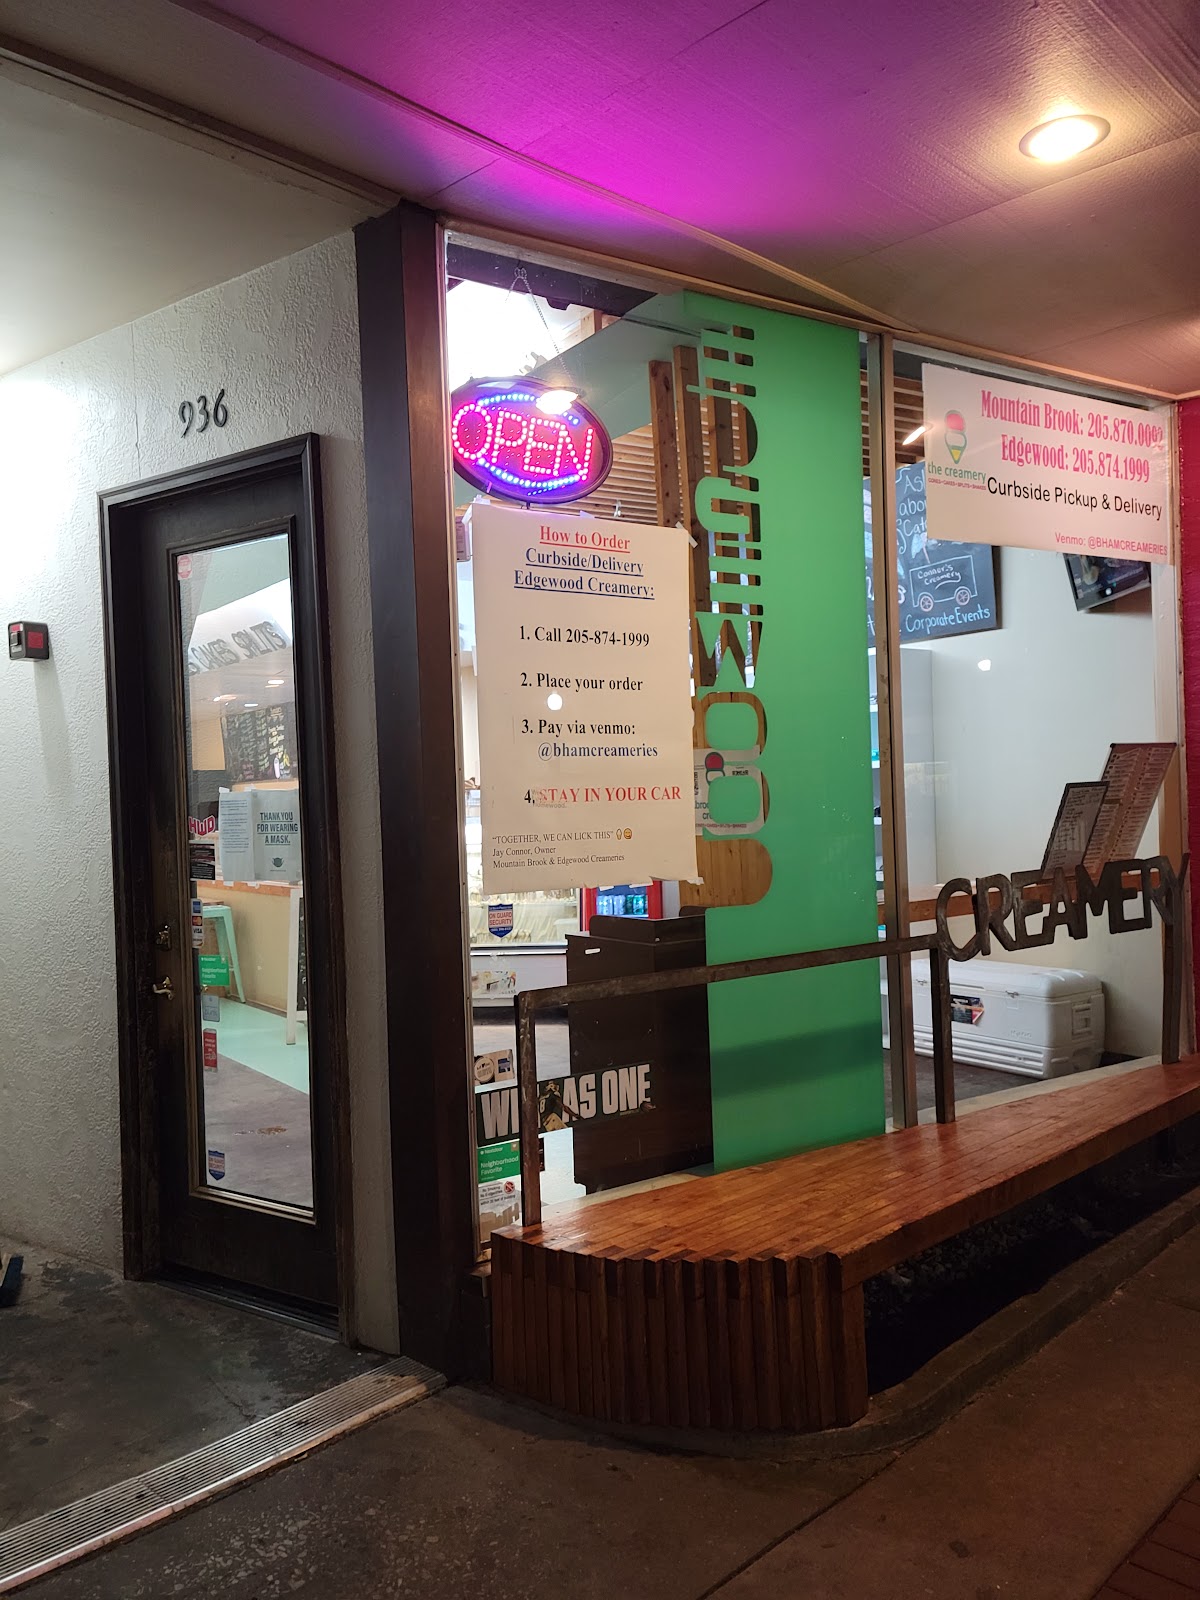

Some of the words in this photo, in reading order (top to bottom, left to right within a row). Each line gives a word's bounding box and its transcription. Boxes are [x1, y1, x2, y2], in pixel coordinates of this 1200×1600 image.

[179, 388, 228, 438] 936
[981, 390, 1040, 427] Mountain
[1044, 403, 1083, 435] Brook:
[452, 403, 593, 481] OPEN
[1001, 434, 1068, 470] Edgewood:
[1072, 447, 1150, 482] 205.874.1999
[928, 461, 942, 475] the
[945, 467, 986, 484] creamery
[987, 477, 1050, 501] Curbside
[1055, 487, 1098, 511] Pickup
[1102, 494, 1110, 510] &
[1115, 496, 1162, 521] Delivery
[540, 525, 571, 543] How
[575, 531, 587, 545] to
[591, 532, 630, 549] Order
[1055, 532, 1086, 546] Venmo:
[1088, 536, 1168, 556] @BHAMCREAMERIES
[525, 547, 644, 574] Curbside/Delivery
[514, 570, 583, 589] Edgewood
[588, 577, 654, 598] Creamery:
[690, 323, 773, 906] EDGEWOOD
[906, 611, 955, 634] Corporate
[954, 604, 990, 623] Events
[520, 625, 530, 640] 1.
[534, 626, 561, 642] Call
[566, 628, 650, 647] 205-874-1999
[520, 672, 532, 687] 2.
[537, 673, 571, 688] Place
[575, 678, 605, 692] your
[609, 677, 643, 691] order
[521, 719, 533, 734] 3.
[538, 719, 563, 737] Pay
[567, 720, 586, 734] via
[590, 724, 636, 735] venmo:
[538, 742, 658, 761] @bhamcreameries
[539, 787, 580, 803] STAY
[585, 787, 601, 802] IN
[605, 786, 647, 802] YOUR
[651, 786, 681, 800] CAR
[260, 812, 280, 821] THANK
[281, 811, 294, 821] YOU
[257, 823, 268, 832] FOR
[270, 823, 298, 832] WEARING
[492, 835, 541, 844] "TOGETHER,
[543, 833, 555, 842] WE
[557, 832, 573, 841] CAN
[574, 831, 592, 840] LICK
[594, 830, 614, 839] THIS"
[265, 835, 269, 844] A
[271, 835, 291, 844] MASK.
[492, 848, 504, 858] Jay
[505, 847, 533, 856] Connor,
[534, 846, 556, 855] Owner
[493, 860, 526, 869] Mountain
[527, 858, 547, 867] Brook
[549, 857, 555, 865] &
[557, 856, 589, 867] Edgewood
[590, 853, 625, 863] Creameries
[489, 912, 496, 920] ON
[497, 911, 512, 919] GUARD
[936, 853, 1190, 962] CREAMERY
[562, 1073, 596, 1123] AS
[602, 1063, 651, 1115] ONE
[480, 1166, 503, 1176] Favorite
[481, 1156, 518, 1169] Neighborhood
